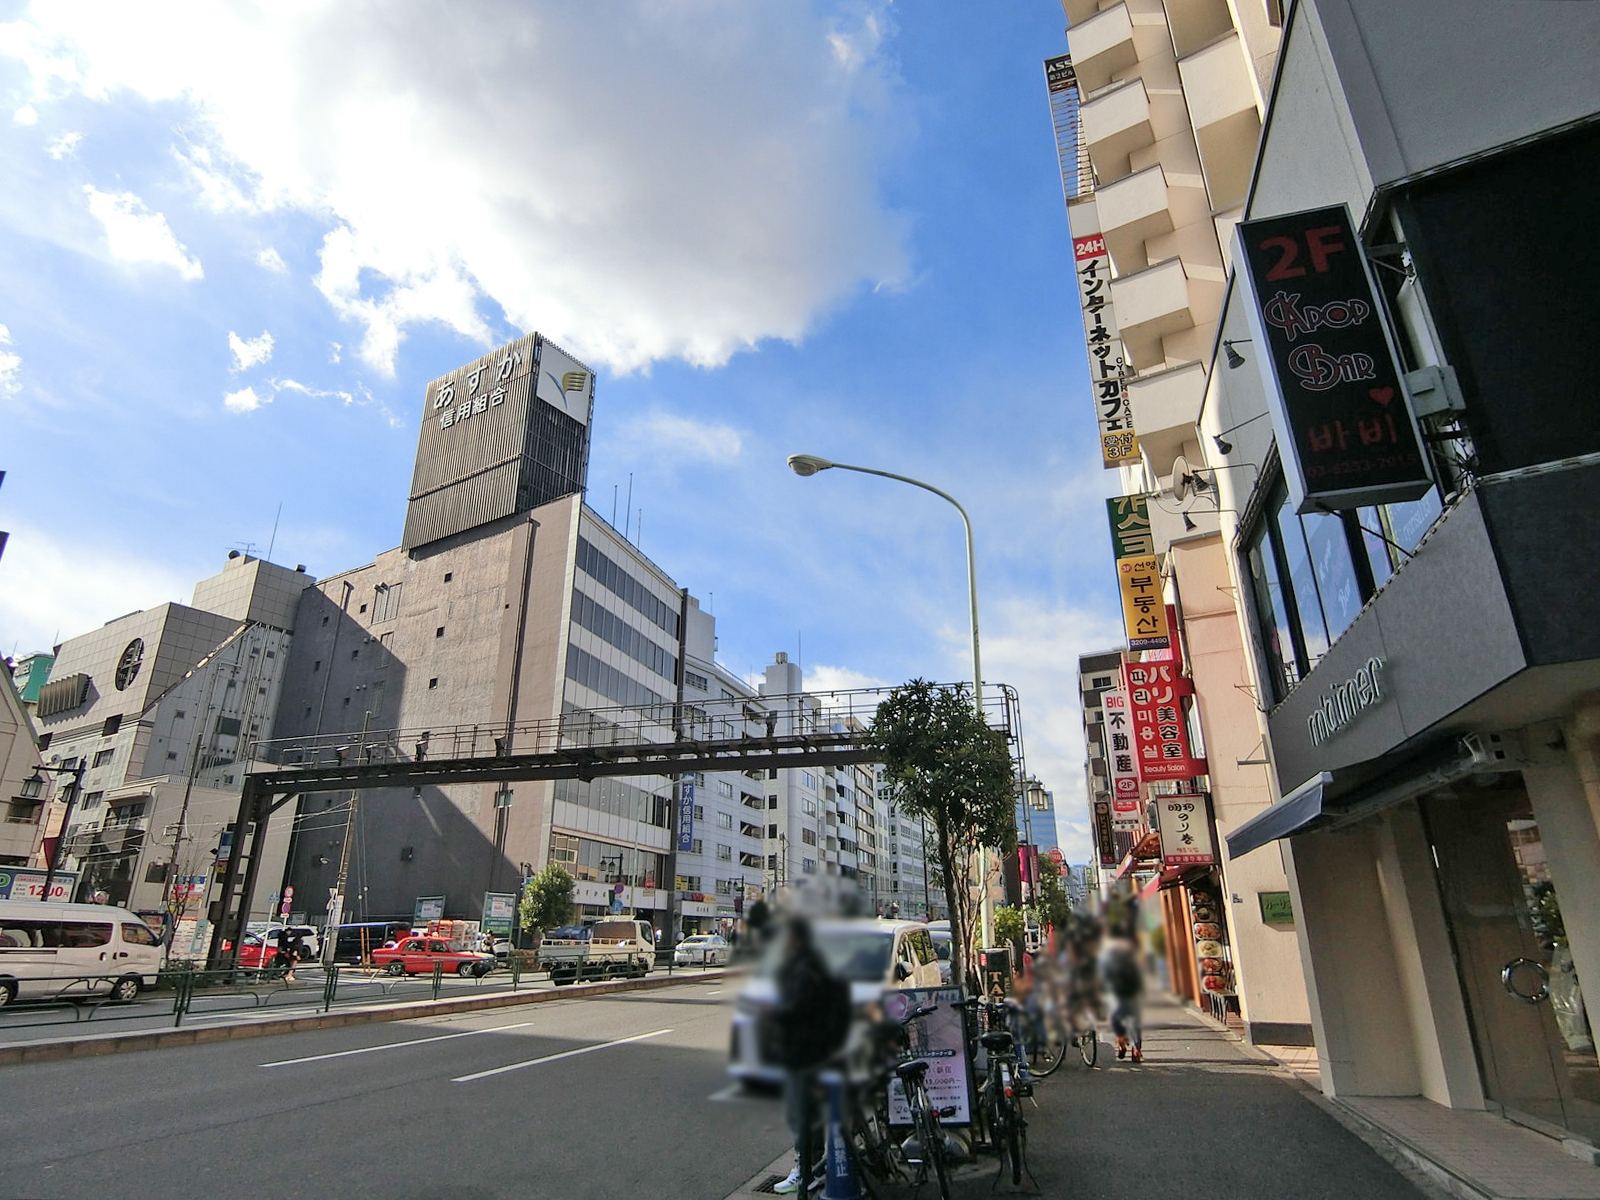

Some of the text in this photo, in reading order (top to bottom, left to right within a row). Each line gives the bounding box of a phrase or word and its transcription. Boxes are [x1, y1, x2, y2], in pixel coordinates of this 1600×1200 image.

[1076, 238, 1105, 257] 24H
[1260, 225, 1346, 282] 2F
[1081, 259, 1123, 431] インターネットカフェ
[433, 351, 523, 409] あすか
[440, 386, 509, 430] 信用組合
[1104, 433, 1133, 446] 受付
[1107, 446, 1133, 459] 3F
[1113, 495, 1146, 515] 7F
[1130, 576, 1158, 635] 부동산
[1106, 696, 1124, 708] BIG
[1131, 670, 1158, 759] 파리미용실
[1149, 665, 1183, 759] パリ美容室
[1109, 712, 1133, 772] 不動産
[1120, 781, 1133, 789] 2F
[1144, 763, 1186, 773] Beauty Salon
[682, 774, 693, 843] すか信用組合
